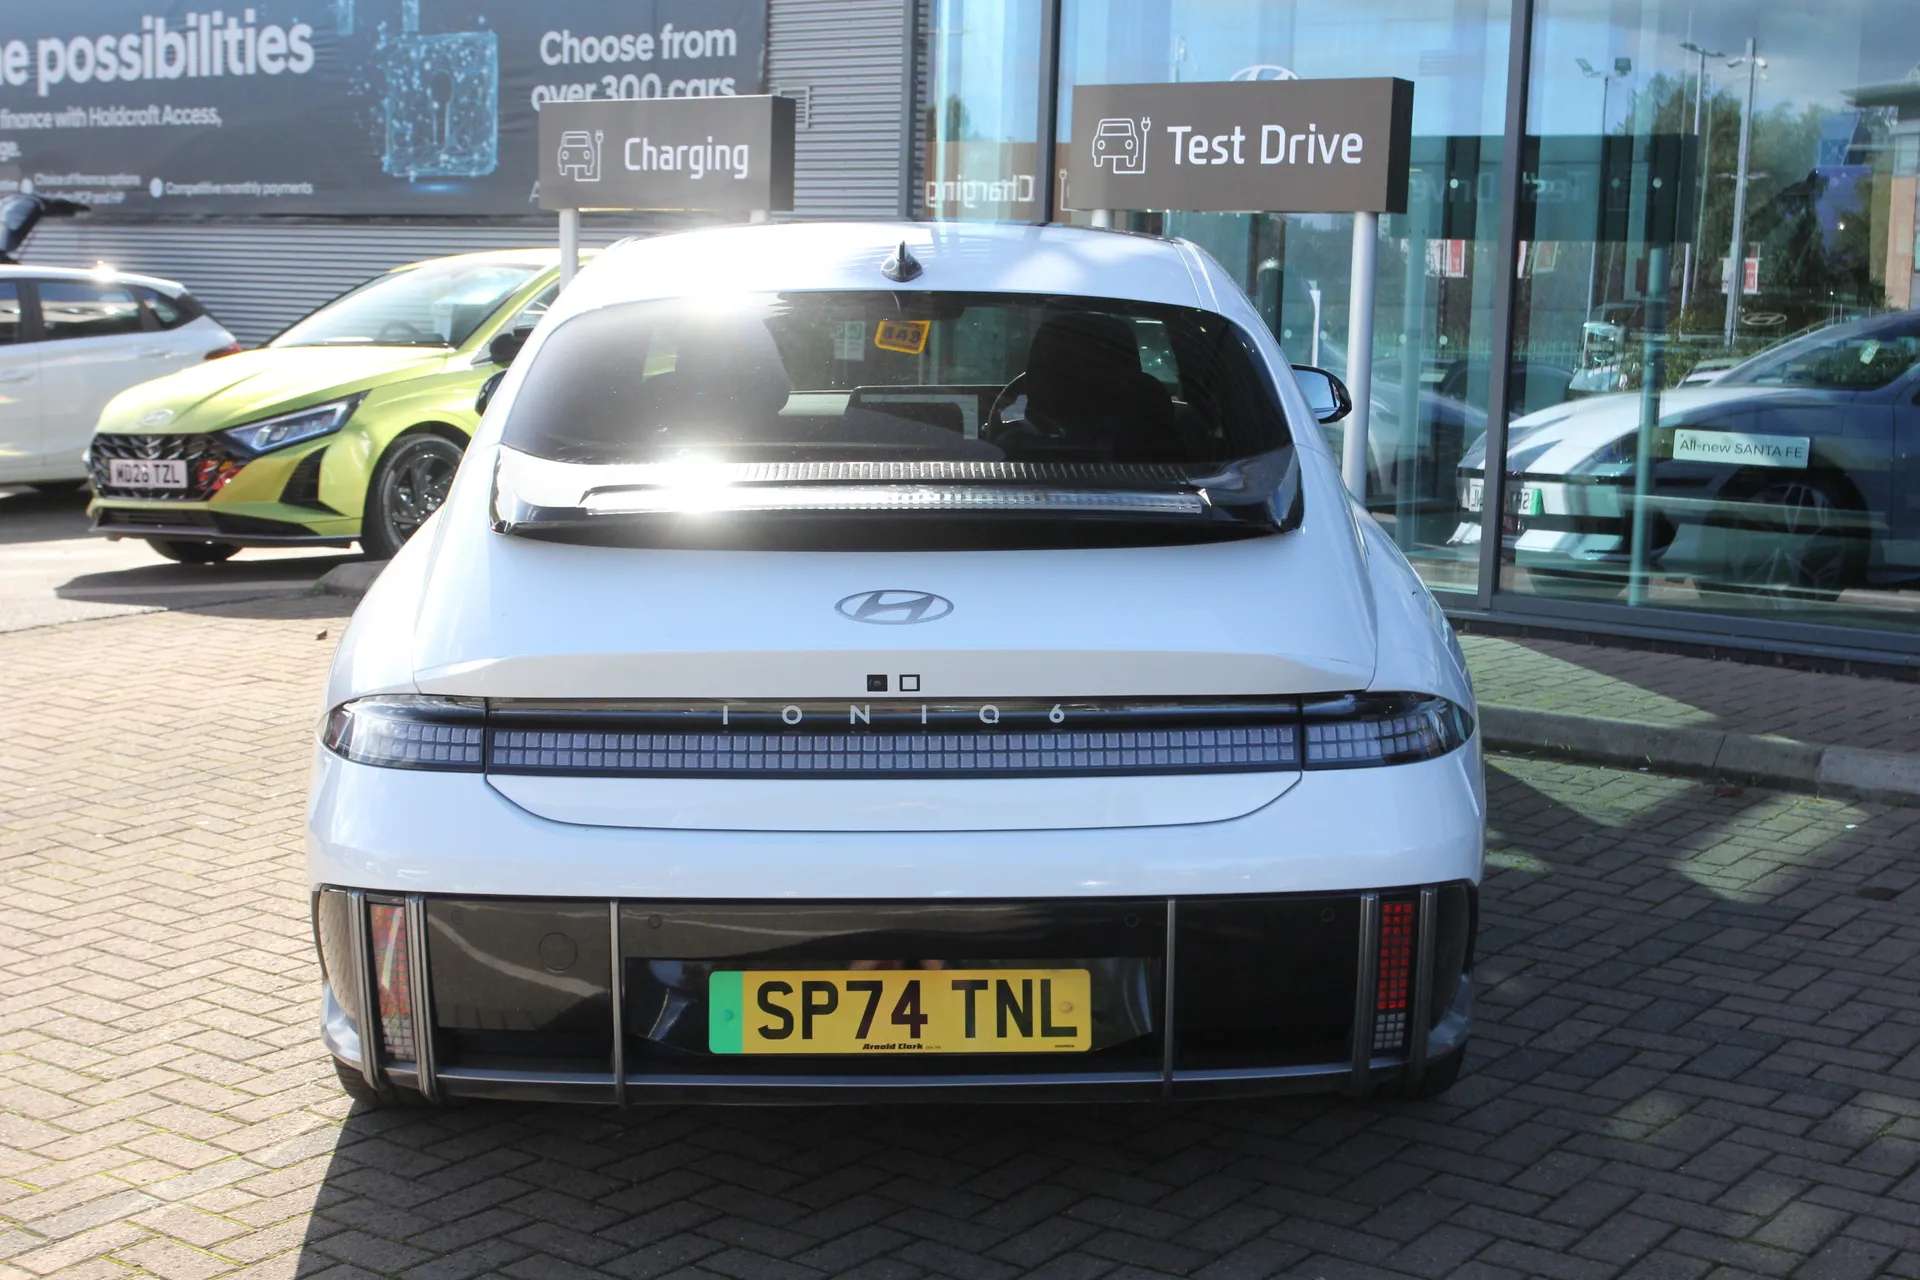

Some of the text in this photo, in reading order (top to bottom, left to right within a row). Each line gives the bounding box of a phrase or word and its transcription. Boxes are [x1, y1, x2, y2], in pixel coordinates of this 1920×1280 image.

[0, 8, 314, 97] e possibilities
[540, 23, 737, 65] Choose from
[531, 73, 735, 112] over 300 cars
[0, 109, 51, 129] finance
[55, 106, 87, 128] with
[162, 105, 222, 127] Access,
[624, 136, 748, 179] Charging
[1167, 124, 1363, 165] Test Drive
[1680, 439, 1804, 458] All-new SANTA FE
[757, 978, 1078, 1040] SP74 TNL
